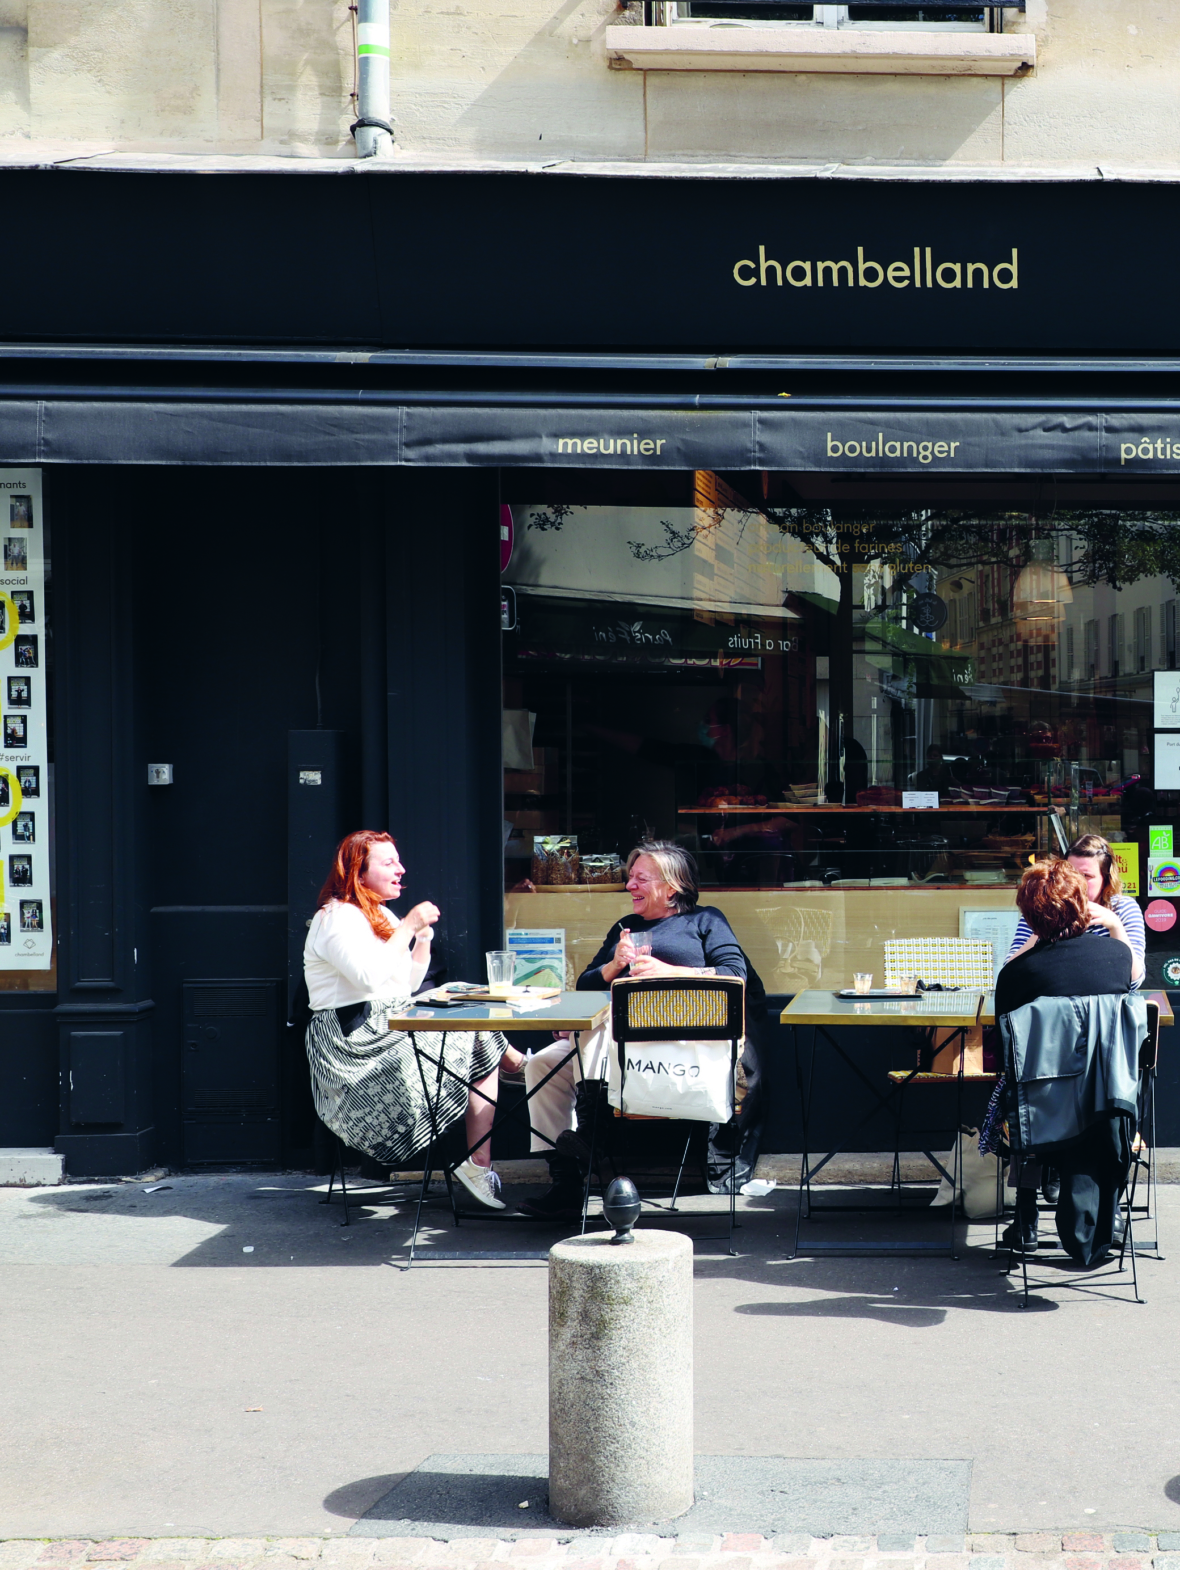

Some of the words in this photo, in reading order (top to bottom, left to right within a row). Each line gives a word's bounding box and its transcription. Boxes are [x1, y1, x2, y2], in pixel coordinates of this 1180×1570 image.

[733, 245, 1018, 289] chambelland
[557, 433, 666, 455] meunier
[827, 432, 960, 463] boulanger
[803, 520, 875, 535] boulanger
[834, 540, 850, 553] de
[854, 540, 903, 553] farines
[748, 560, 847, 573] naturellement
[888, 558, 932, 576] gluten
[1151, 836, 1169, 849] AB
[626, 1058, 700, 1078] MANGO
